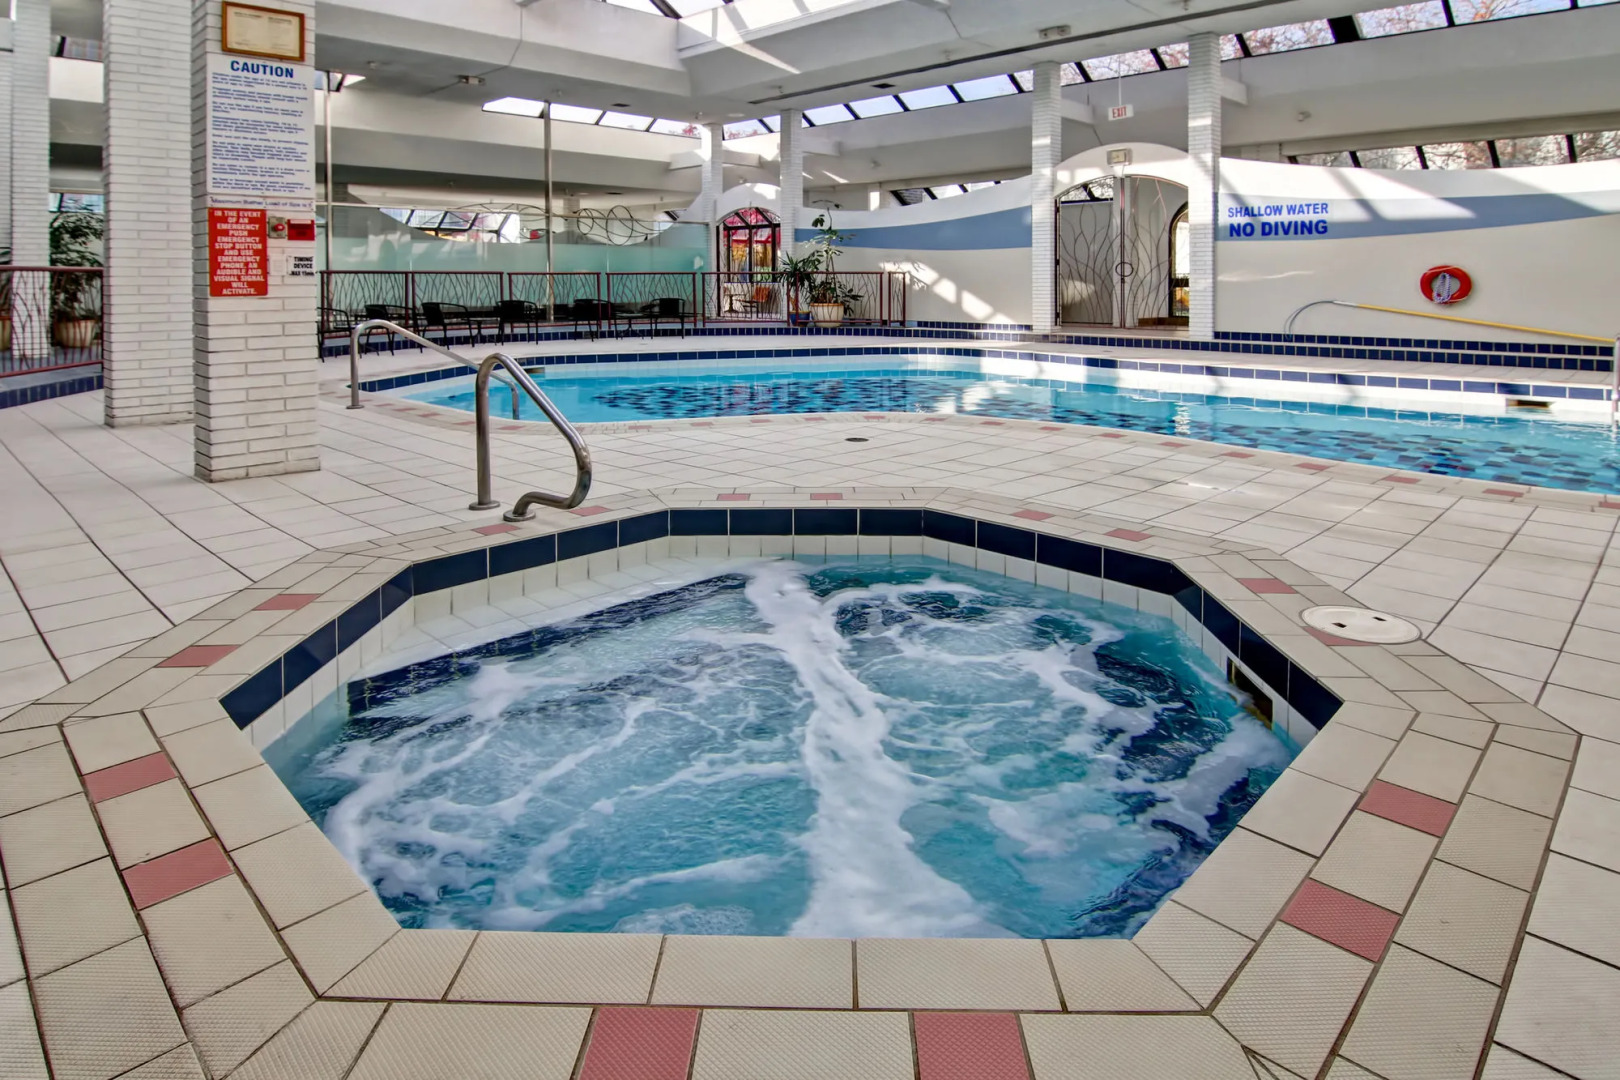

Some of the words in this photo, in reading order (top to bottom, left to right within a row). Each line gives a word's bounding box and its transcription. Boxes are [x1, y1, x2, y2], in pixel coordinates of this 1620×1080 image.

[230, 60, 294, 78] CAUTION
[1112, 106, 1126, 118] EXIT
[1228, 205, 1283, 217] SHALLOW
[1287, 203, 1328, 215] WATER
[1229, 222, 1255, 237] NO
[1262, 220, 1328, 236] DIVING
